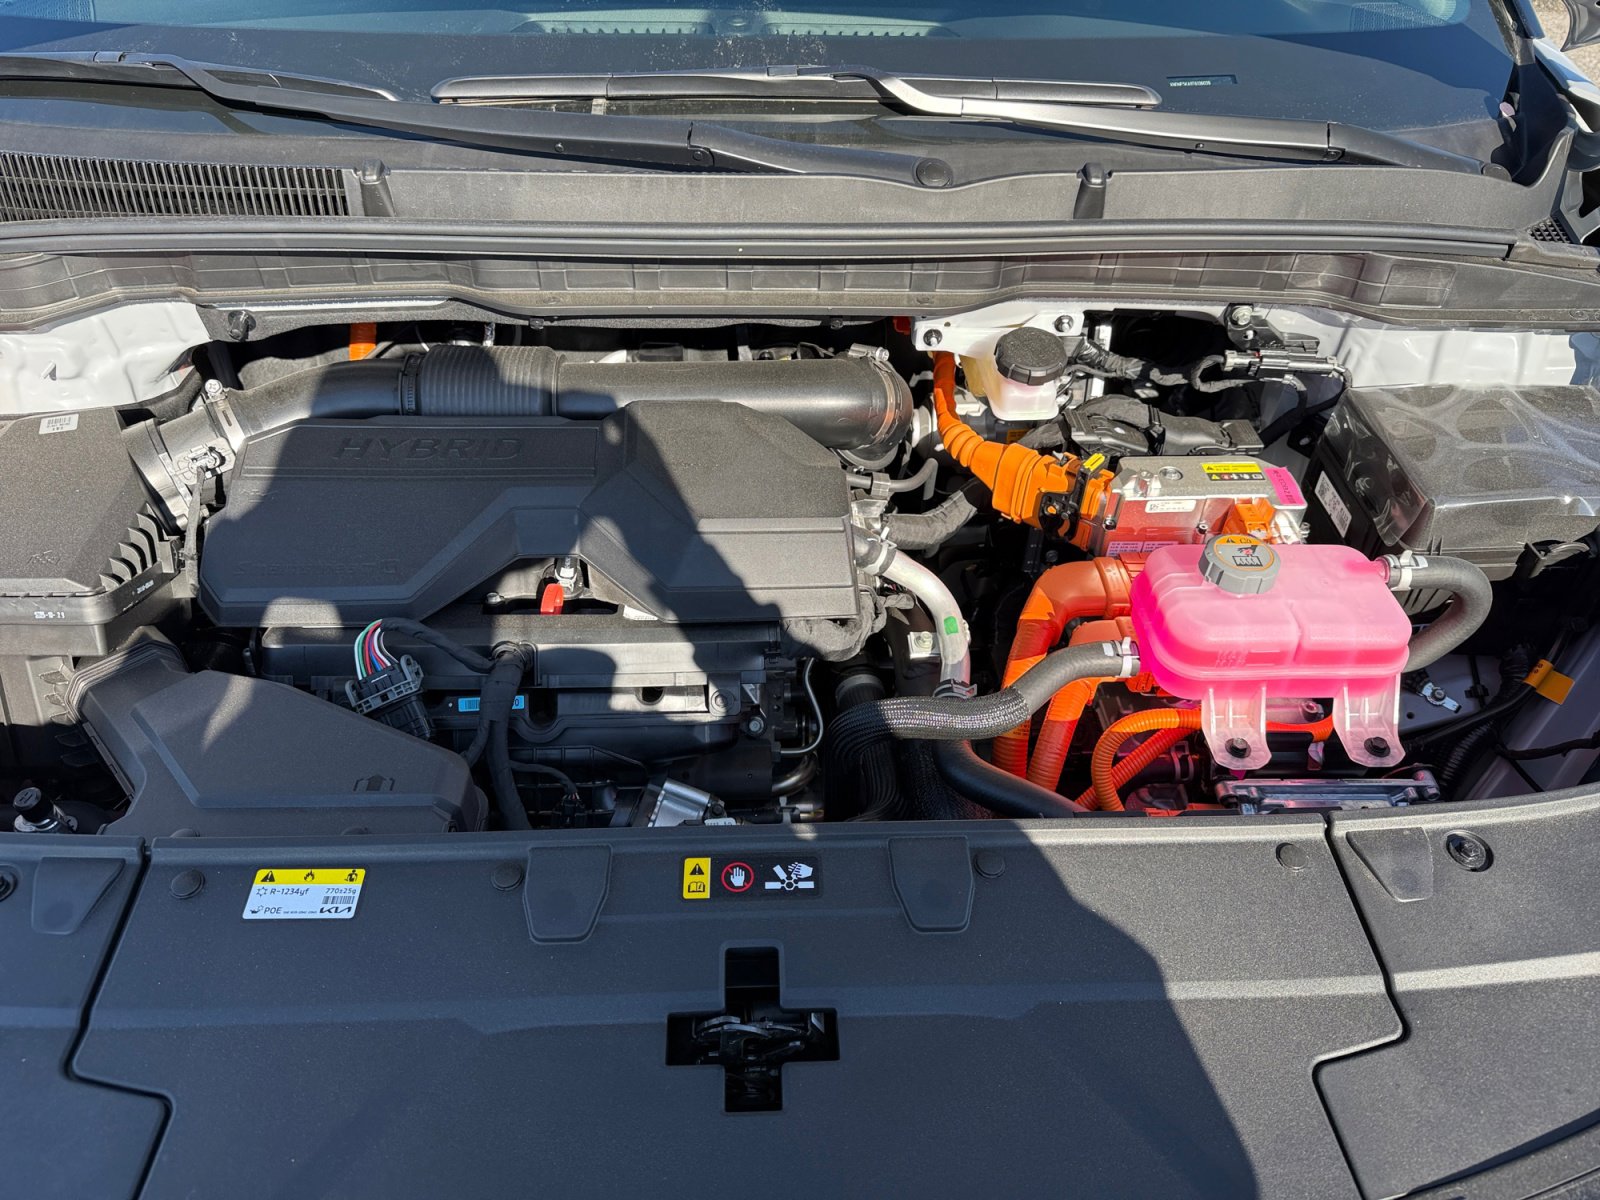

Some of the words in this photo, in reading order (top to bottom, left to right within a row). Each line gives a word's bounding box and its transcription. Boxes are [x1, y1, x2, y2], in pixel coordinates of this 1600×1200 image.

[332, 437, 524, 461] HYBRID
[270, 888, 309, 896] R-1234yf
[264, 907, 282, 915] POE
